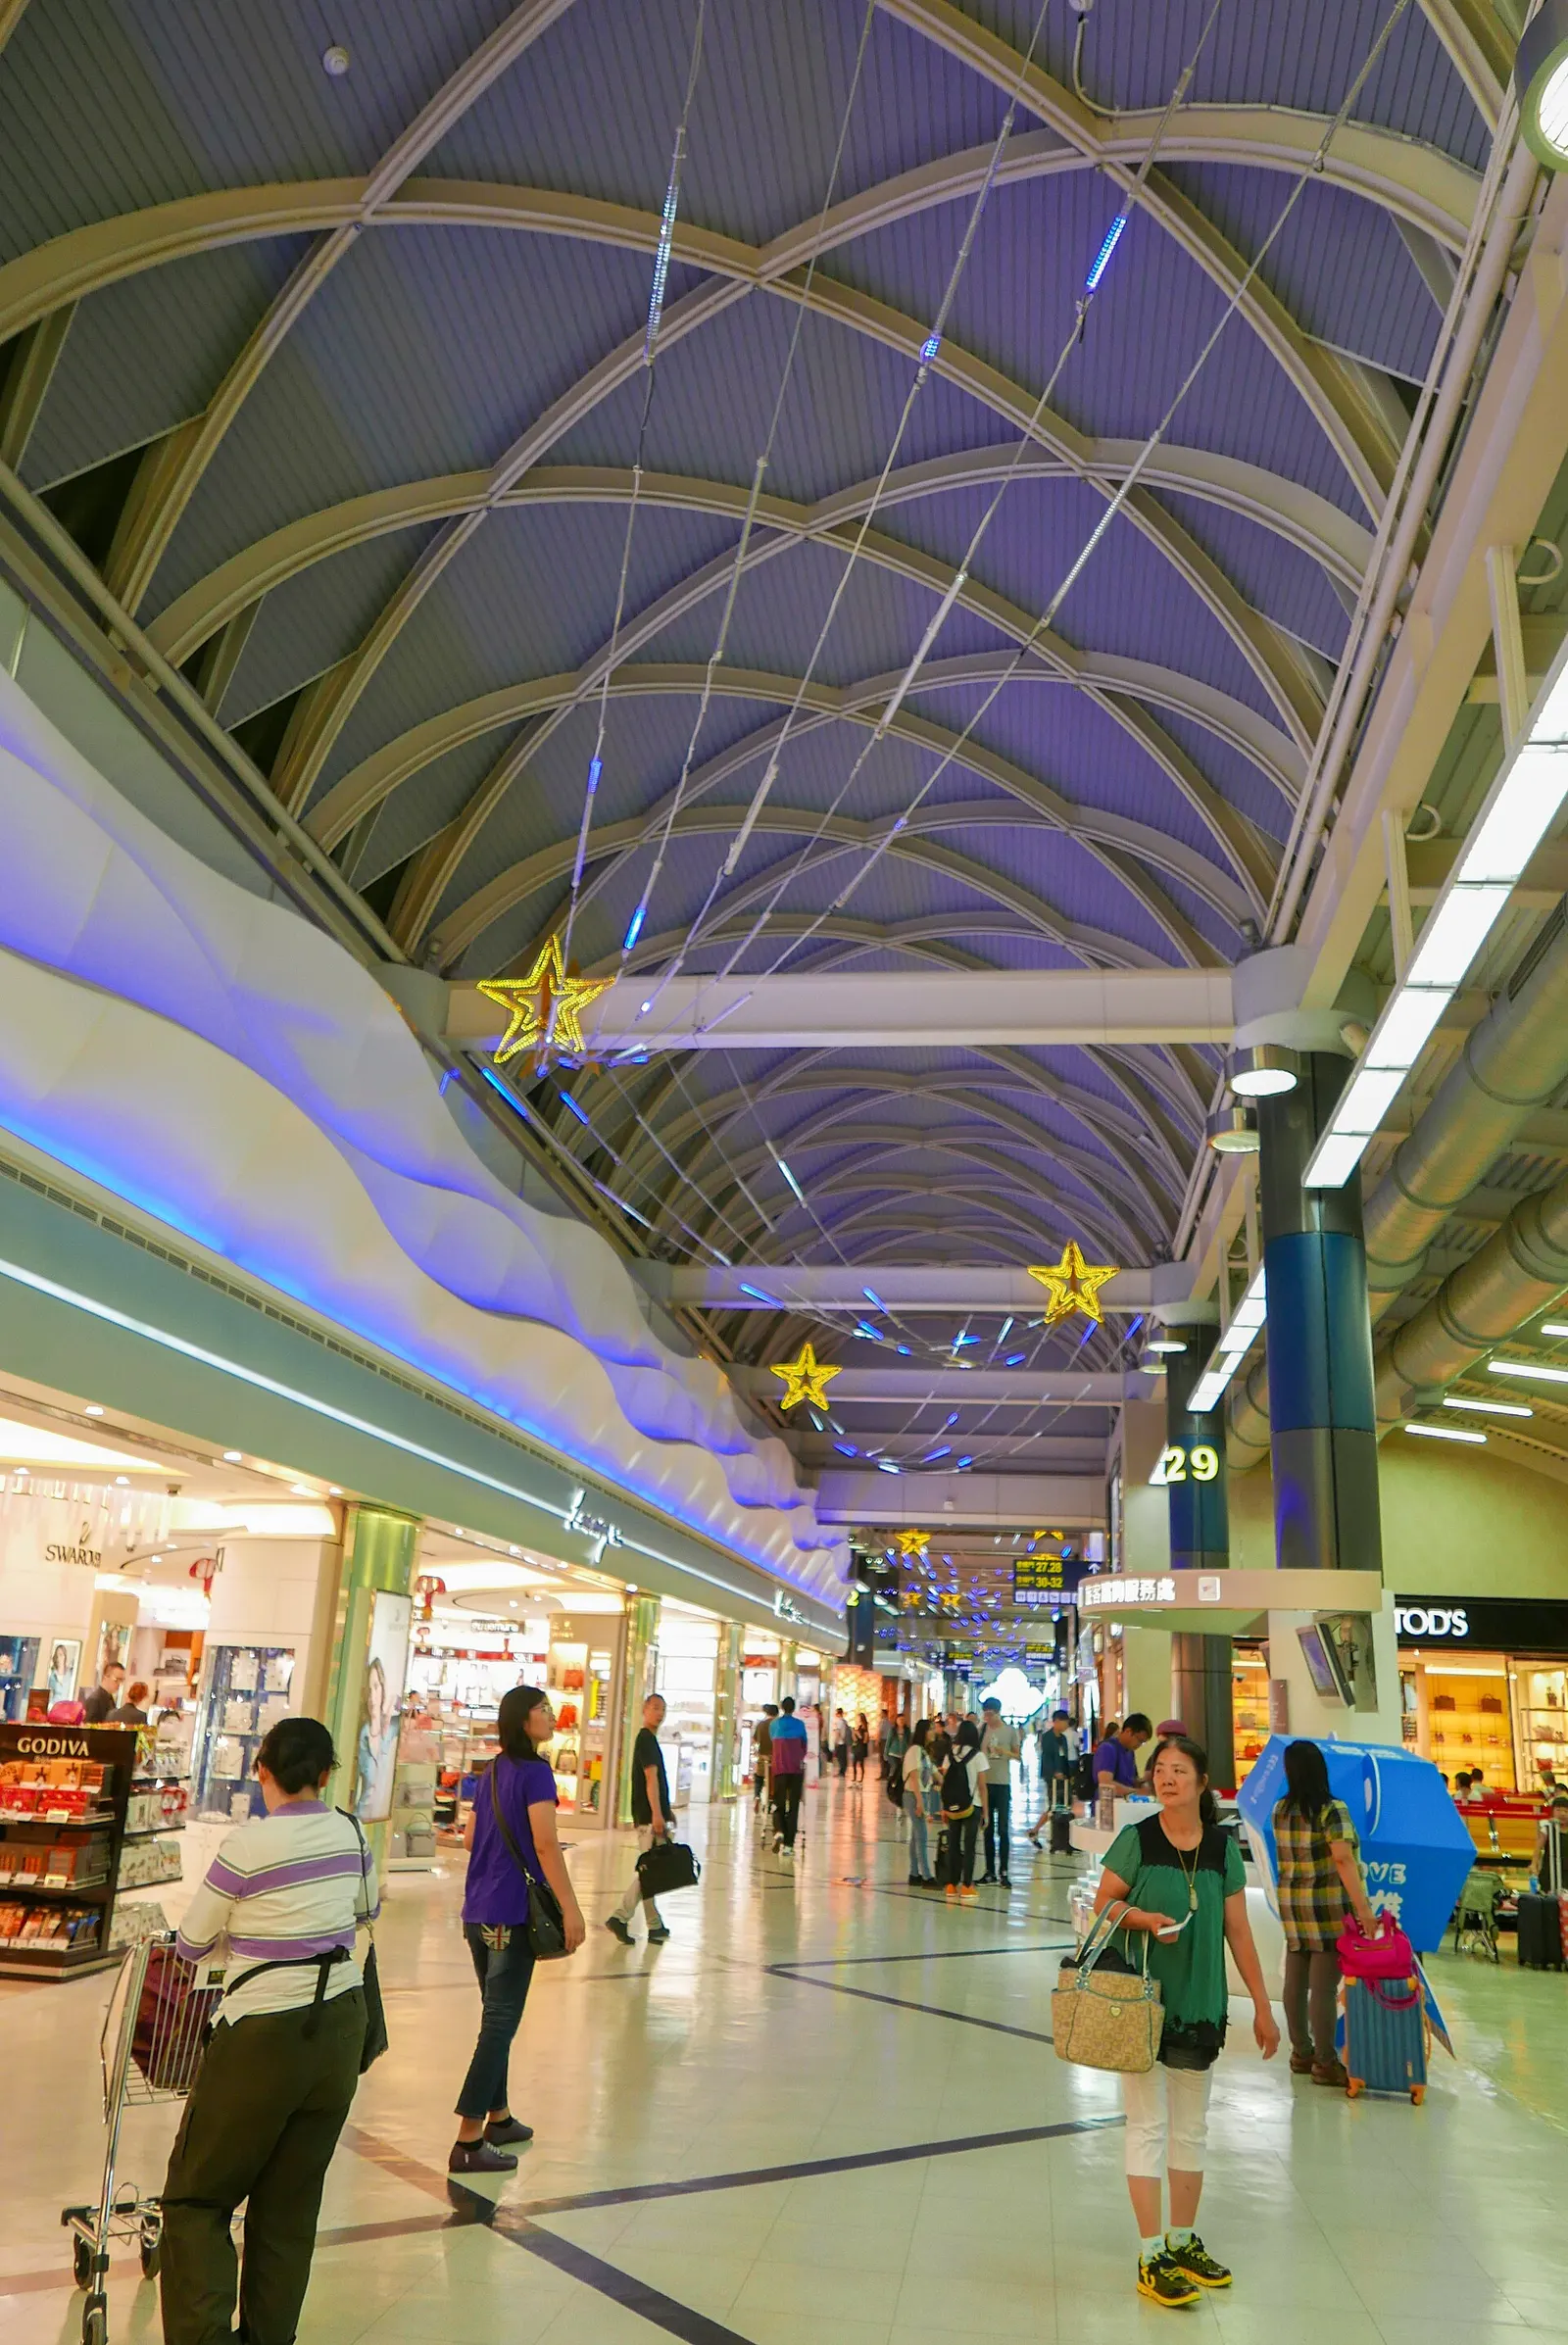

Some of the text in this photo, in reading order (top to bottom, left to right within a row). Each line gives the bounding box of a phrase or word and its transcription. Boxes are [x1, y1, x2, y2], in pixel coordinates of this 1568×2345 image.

[1164, 1445, 1218, 1482] 29
[1394, 1607, 1469, 1637] TOD'S
[17, 1736, 90, 1757] GODIVA
